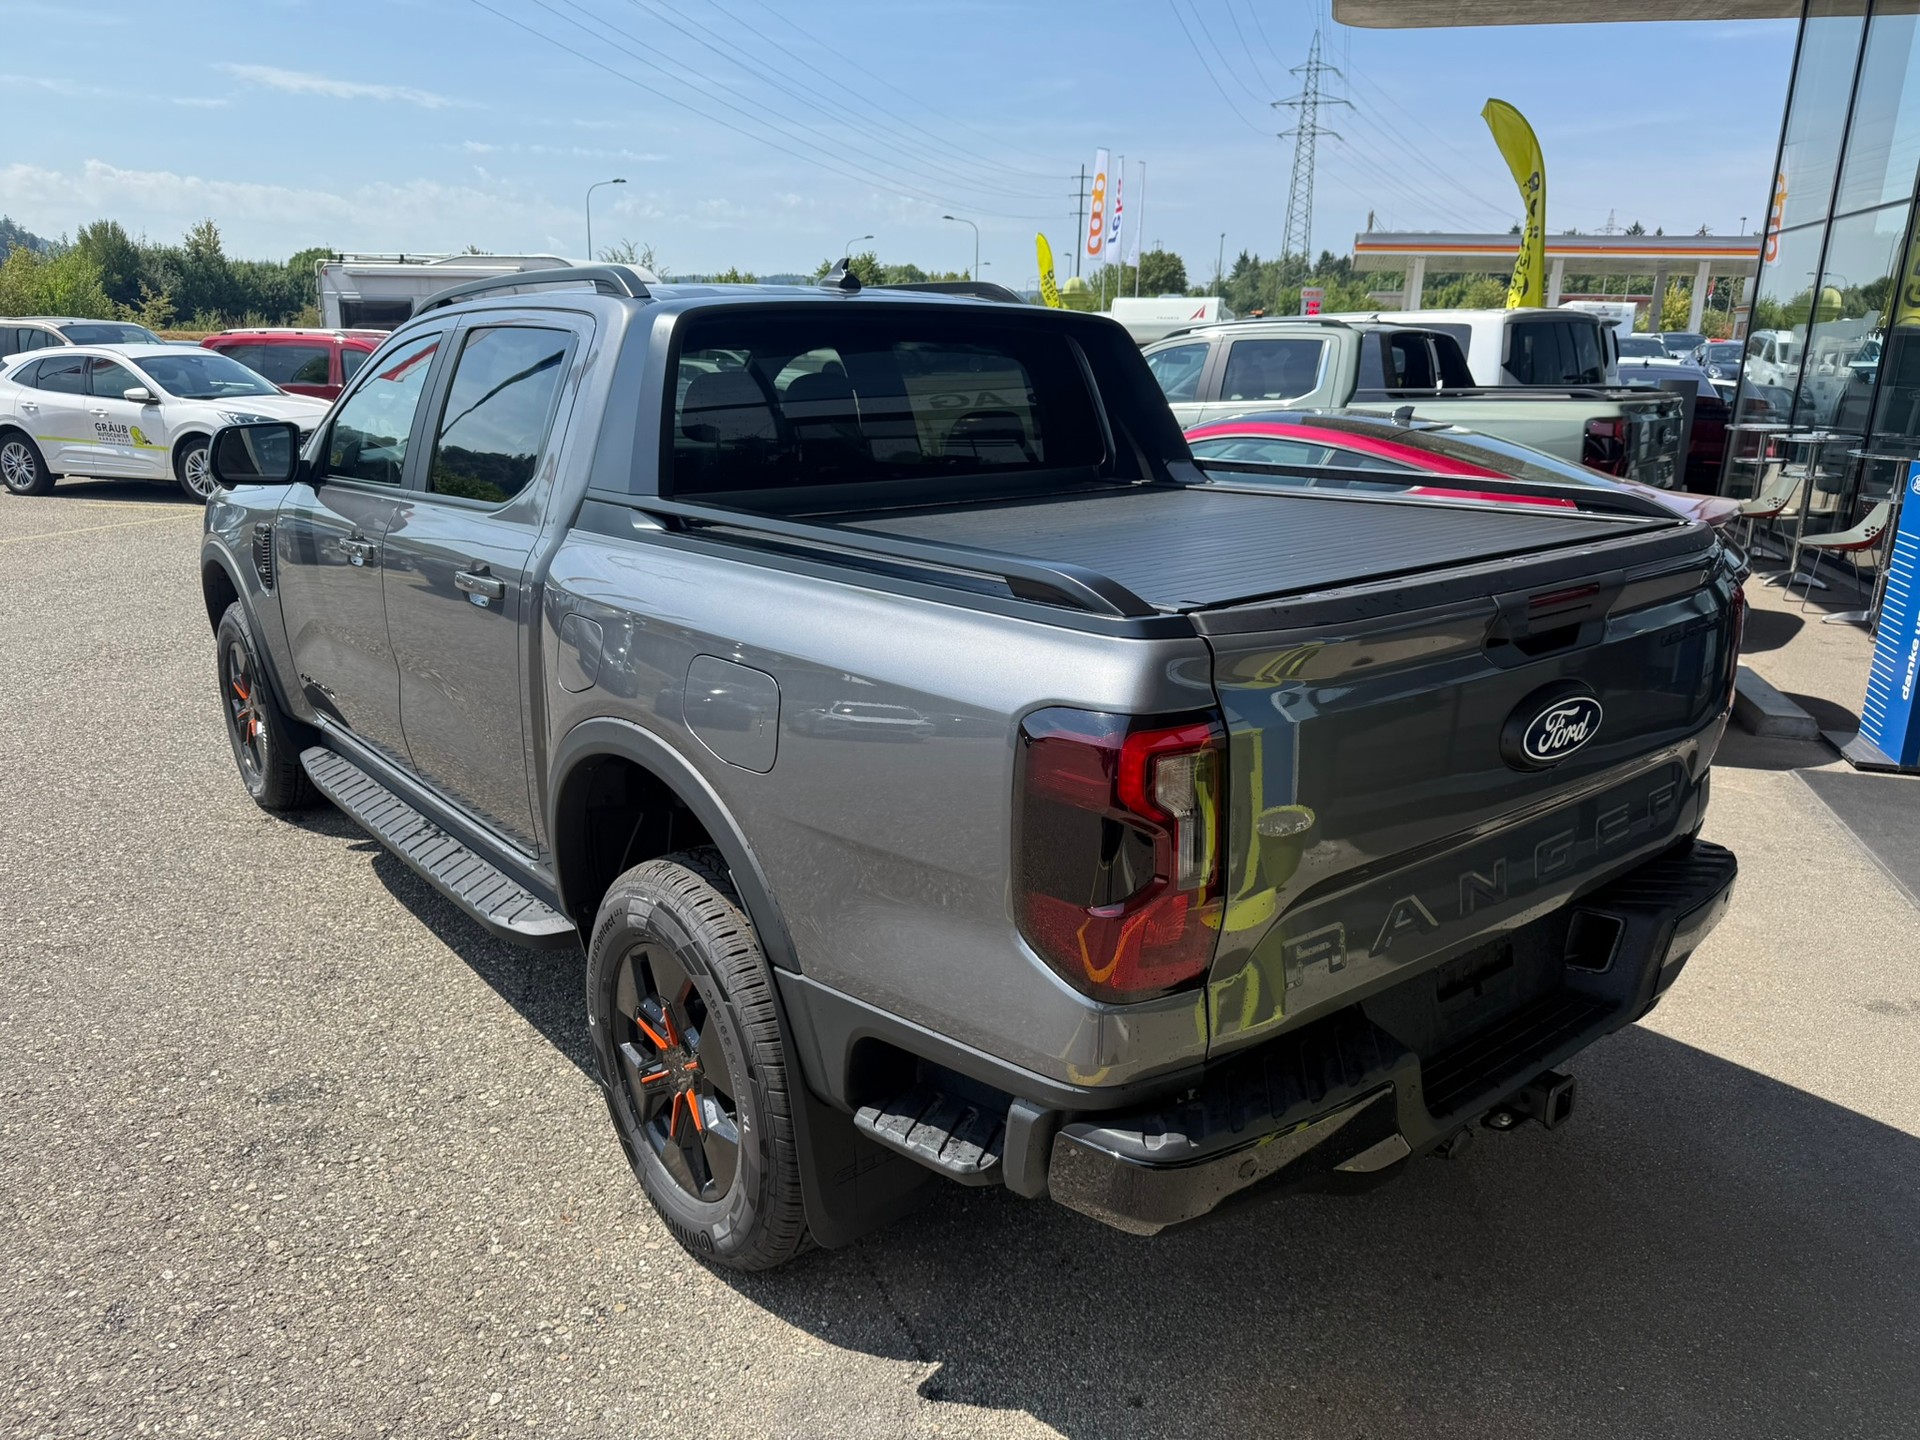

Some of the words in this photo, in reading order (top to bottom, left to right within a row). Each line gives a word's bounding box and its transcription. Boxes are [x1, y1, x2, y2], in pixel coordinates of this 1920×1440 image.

[1088, 173, 1106, 255] coop
[95, 421, 128, 434] GRÄUB
[1901, 637, 1919, 700] danke
[1537, 706, 1592, 753] Ford
[1281, 780, 1677, 992] RANGER
[741, 1111, 751, 1135] XL
